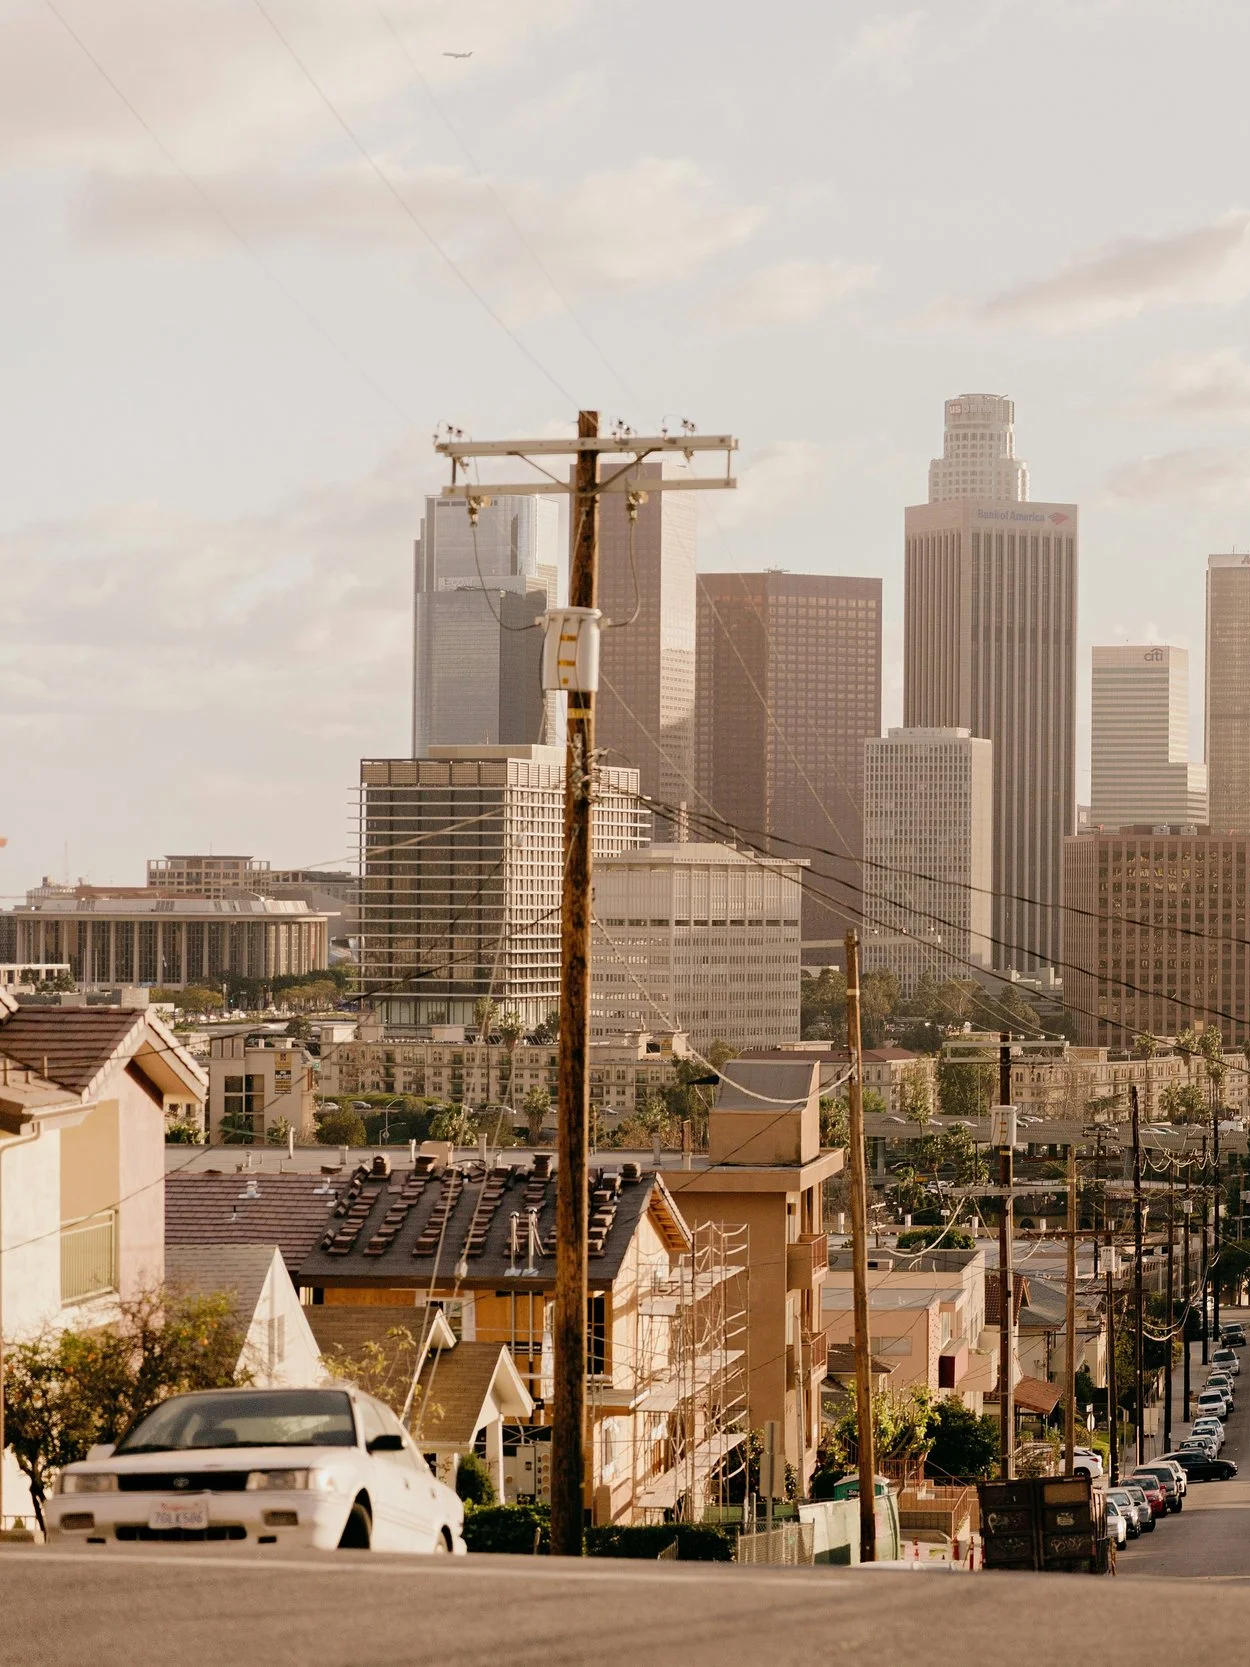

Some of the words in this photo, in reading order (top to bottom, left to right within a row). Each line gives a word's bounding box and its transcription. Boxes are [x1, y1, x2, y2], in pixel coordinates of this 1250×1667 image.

[977, 509, 999, 519] Bank
[1000, 511, 1009, 520] of
[1010, 511, 1045, 521] America
[1144, 648, 1163, 661] citi
